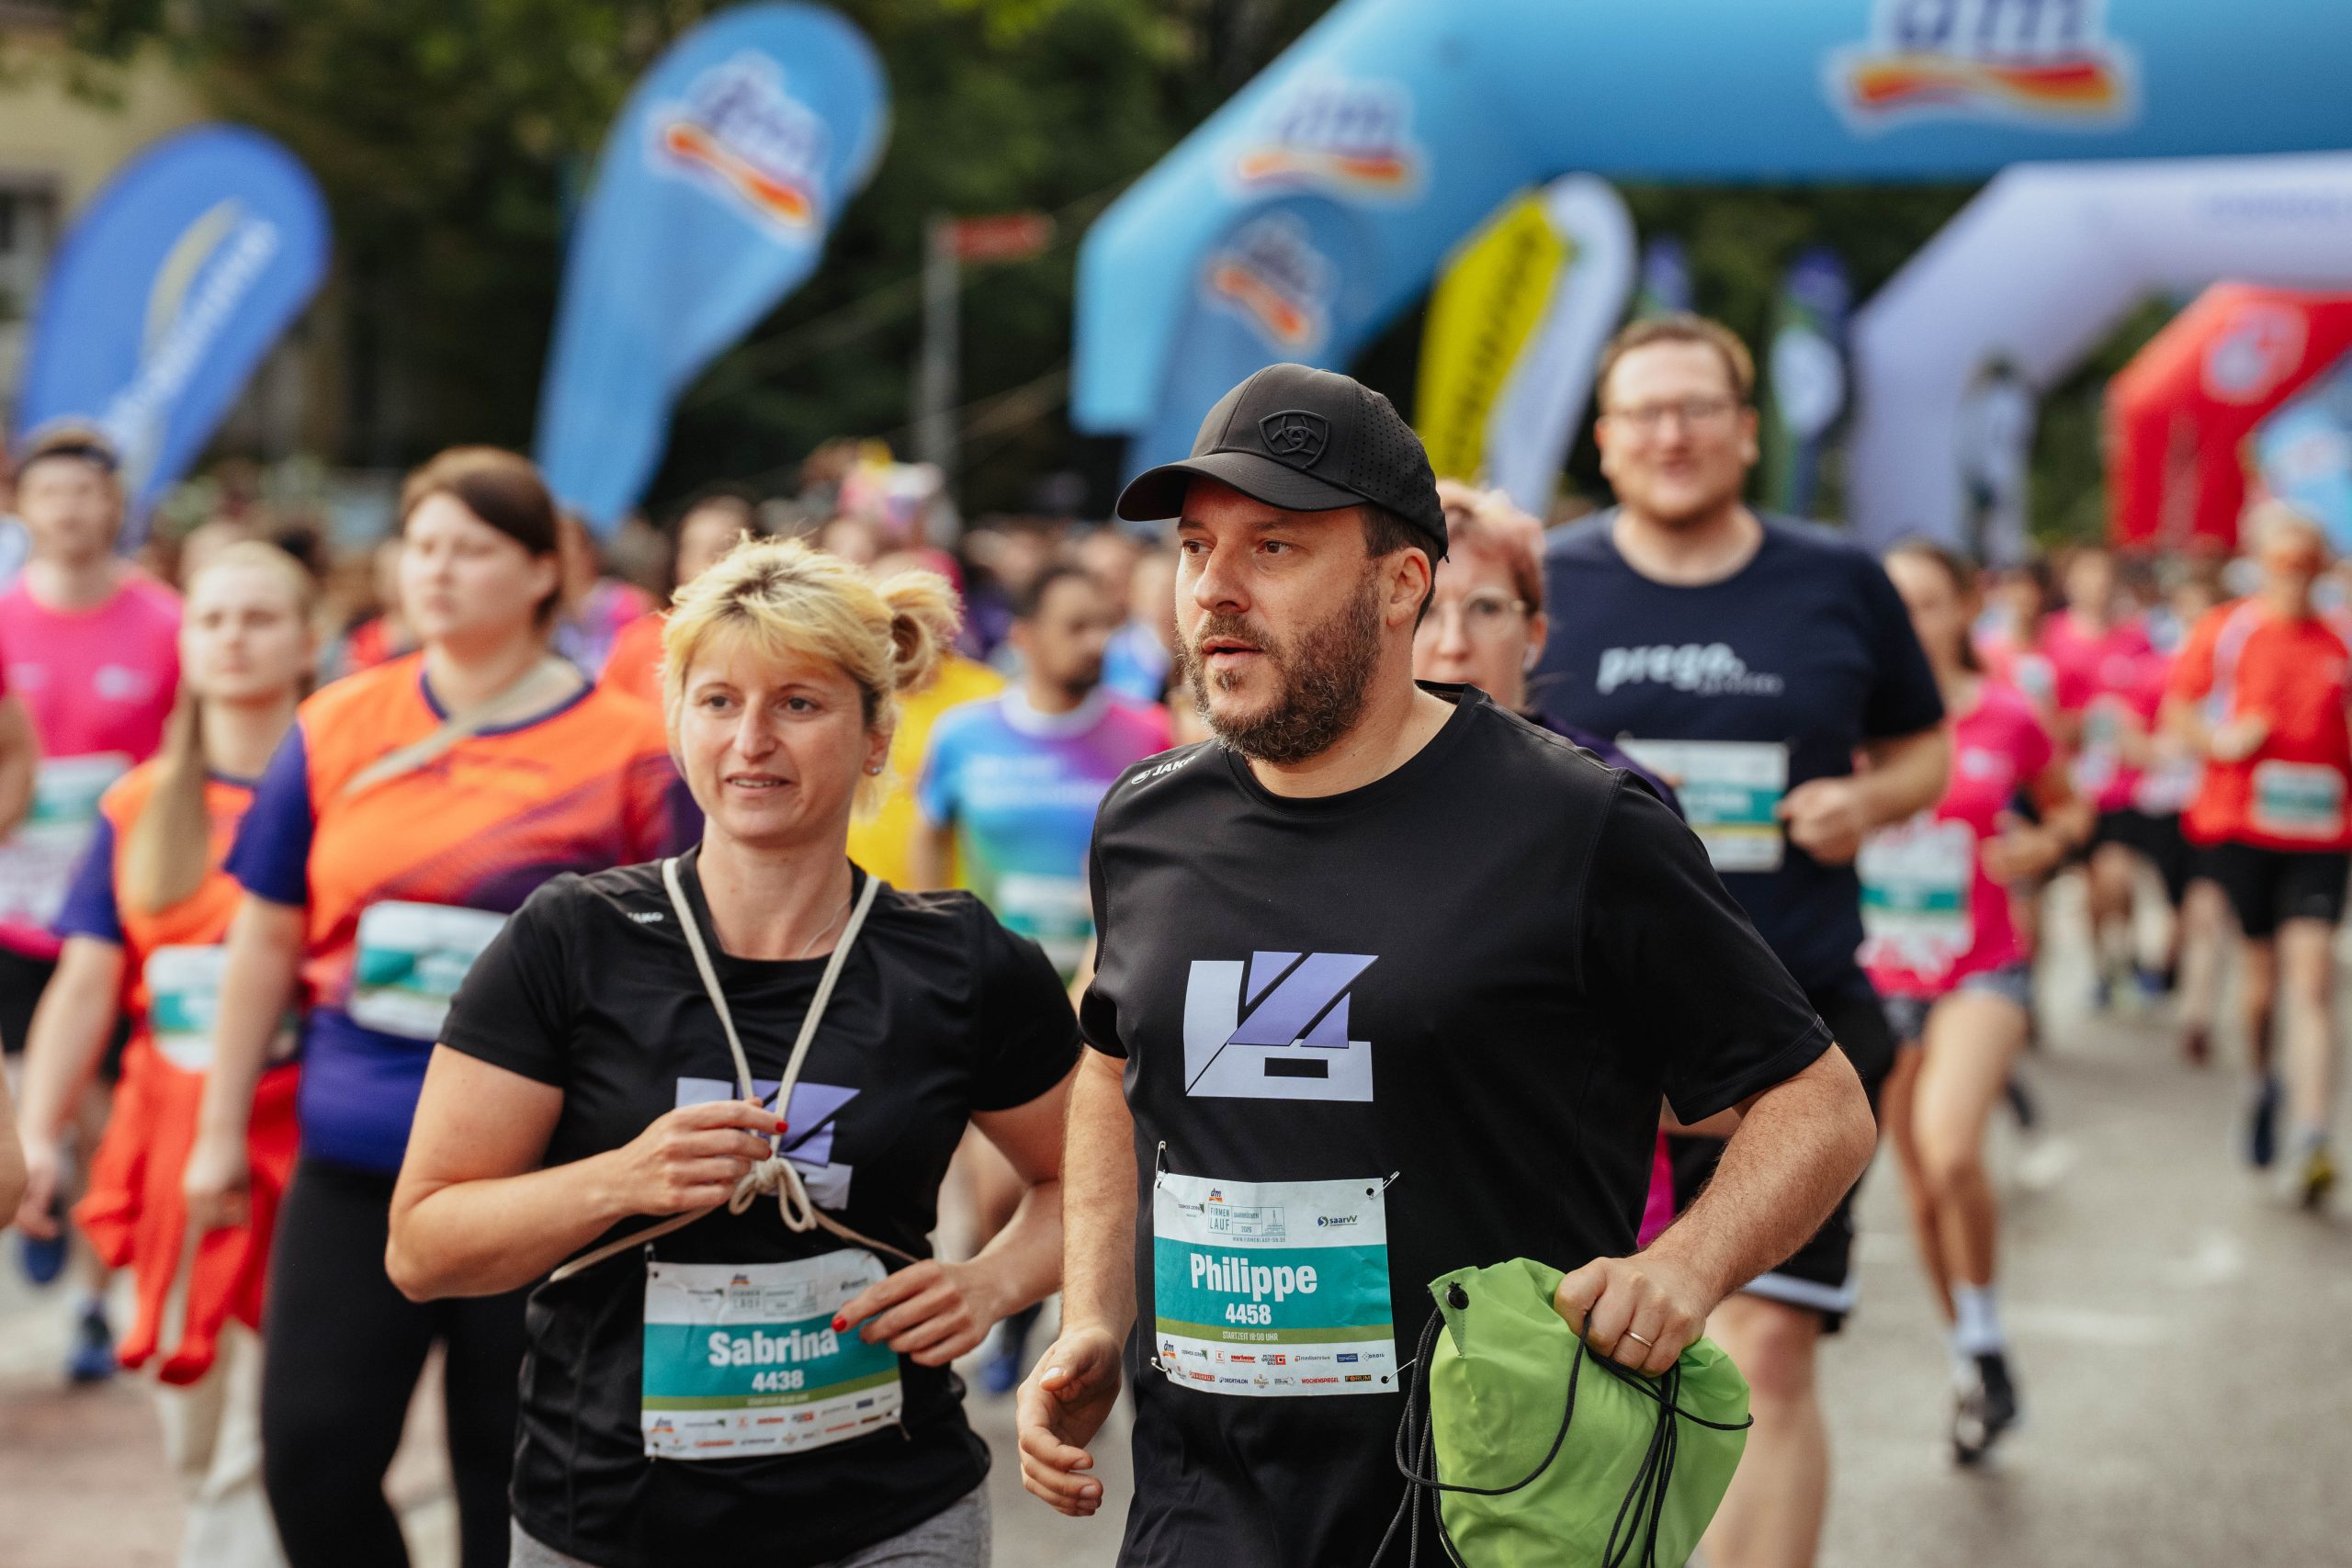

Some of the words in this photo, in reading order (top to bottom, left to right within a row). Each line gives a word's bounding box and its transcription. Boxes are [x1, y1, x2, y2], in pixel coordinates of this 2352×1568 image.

[1210, 1207, 1230, 1216] FIRMEN
[1209, 1218, 1230, 1231] LAUF
[1190, 1253, 1317, 1303] Philippe
[1225, 1303, 1272, 1325] 4458
[707, 1327, 840, 1367] Sabrina
[1222, 1331, 1249, 1340] STARTZEIT
[1250, 1333, 1264, 1341] 18:00
[1265, 1333, 1279, 1341] UHR
[751, 1370, 805, 1393] 4438
